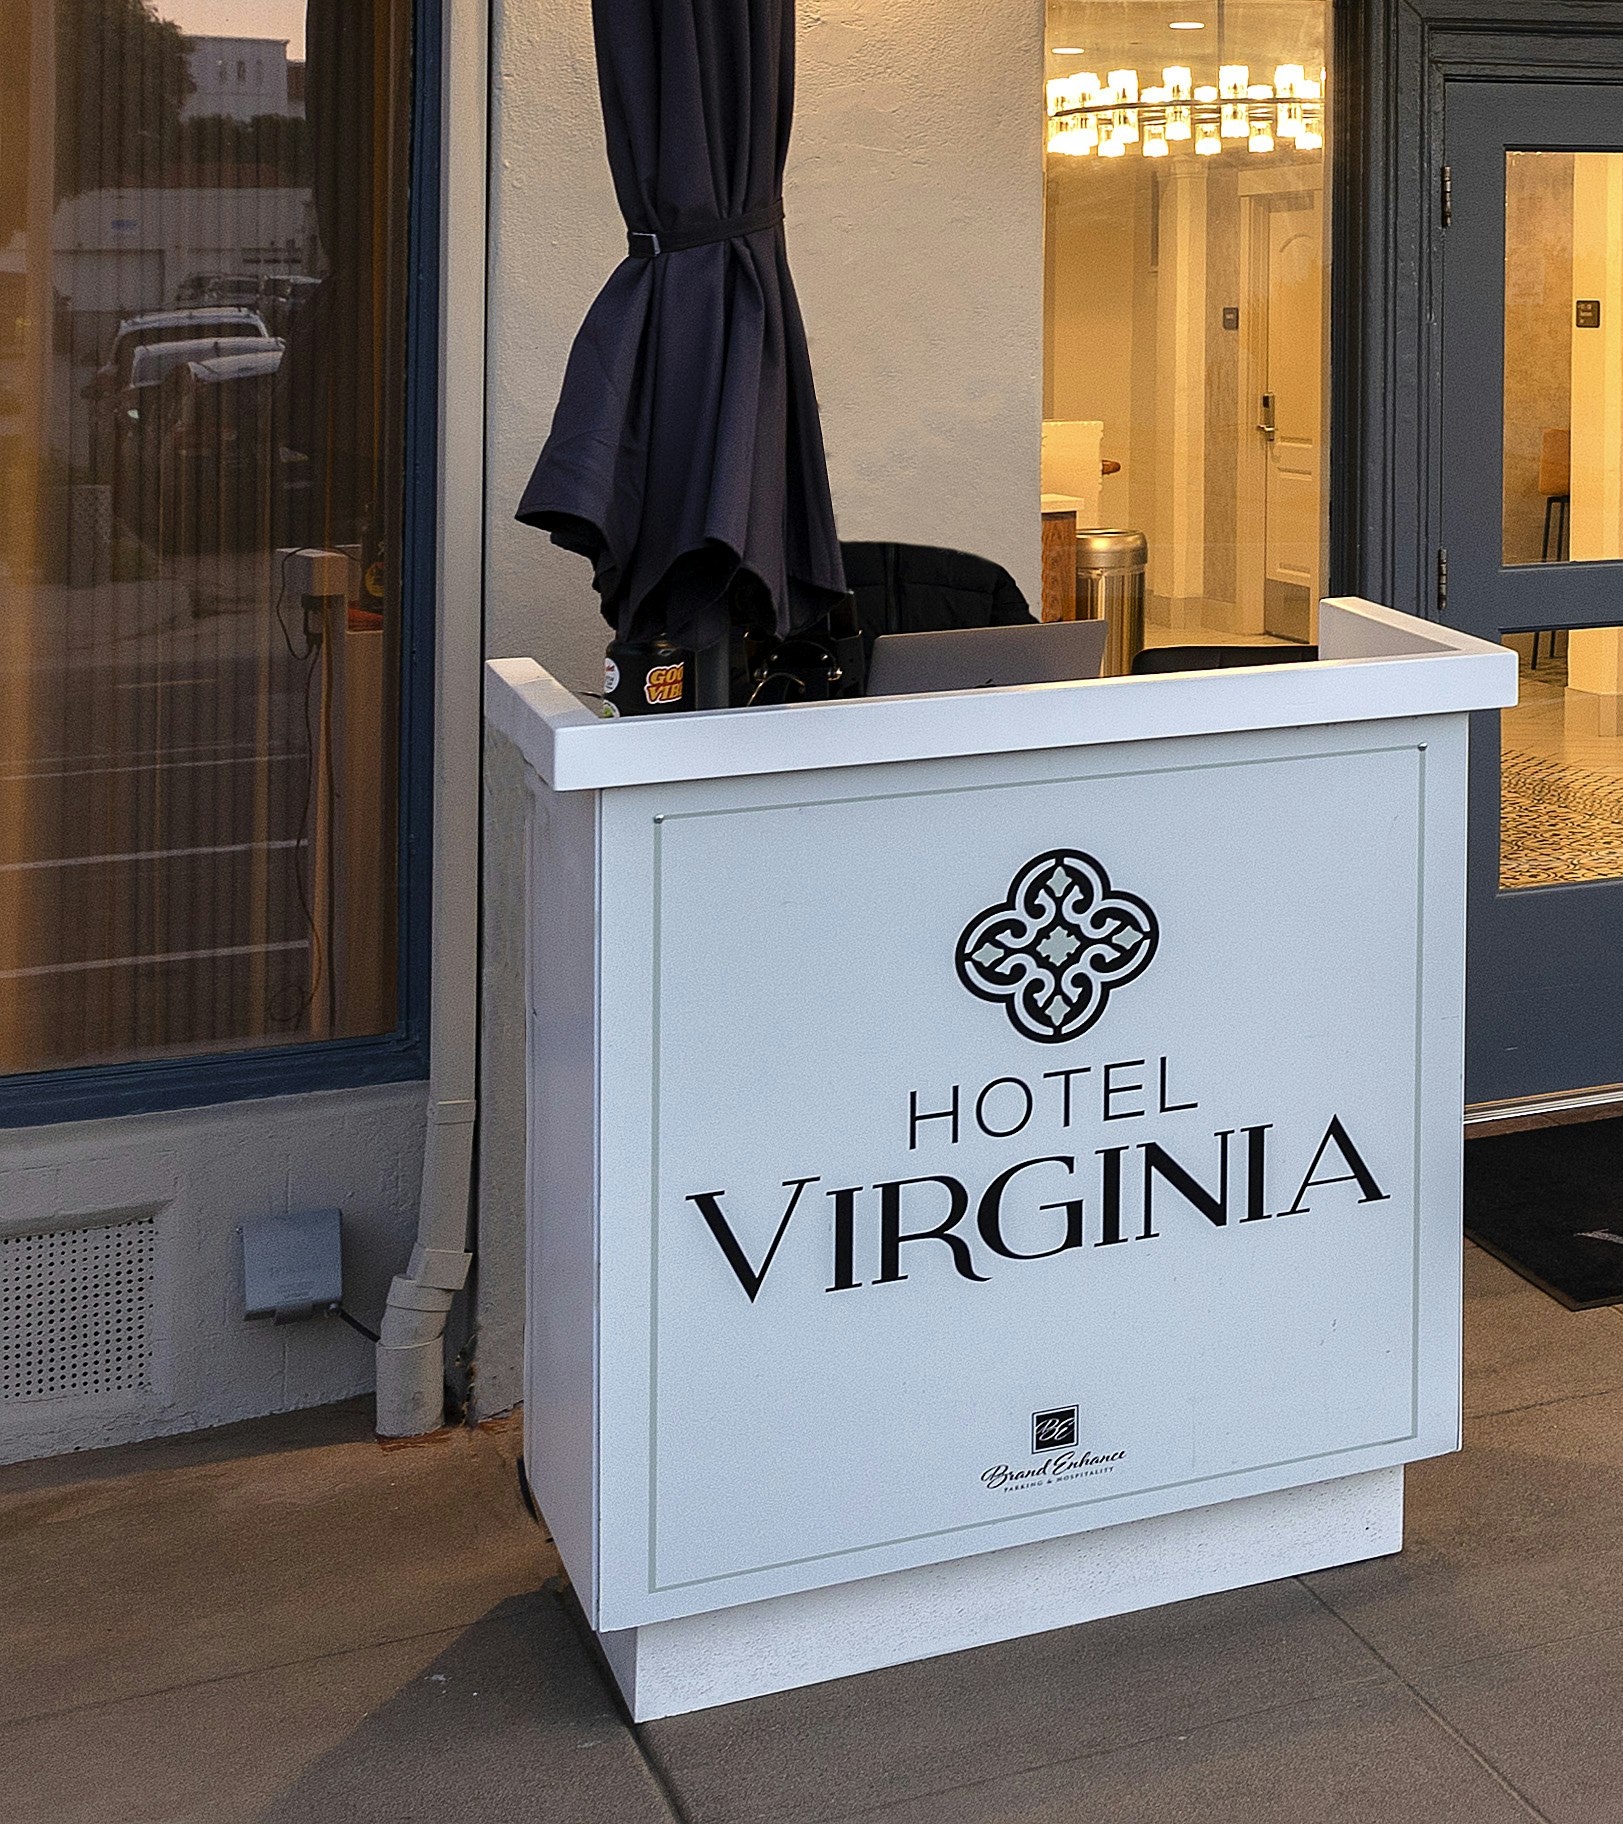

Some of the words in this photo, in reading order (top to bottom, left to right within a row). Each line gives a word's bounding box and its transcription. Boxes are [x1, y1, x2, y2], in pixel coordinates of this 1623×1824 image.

[909, 1056, 1198, 1150] HOTEL
[684, 1113, 1391, 1304] VIRGINIA
[980, 1458, 1053, 1489] Brand
[1051, 1450, 1127, 1477] Enhance
[1003, 1479, 1043, 1493] PARKING
[1056, 1465, 1114, 1482] HOSPITALITY
